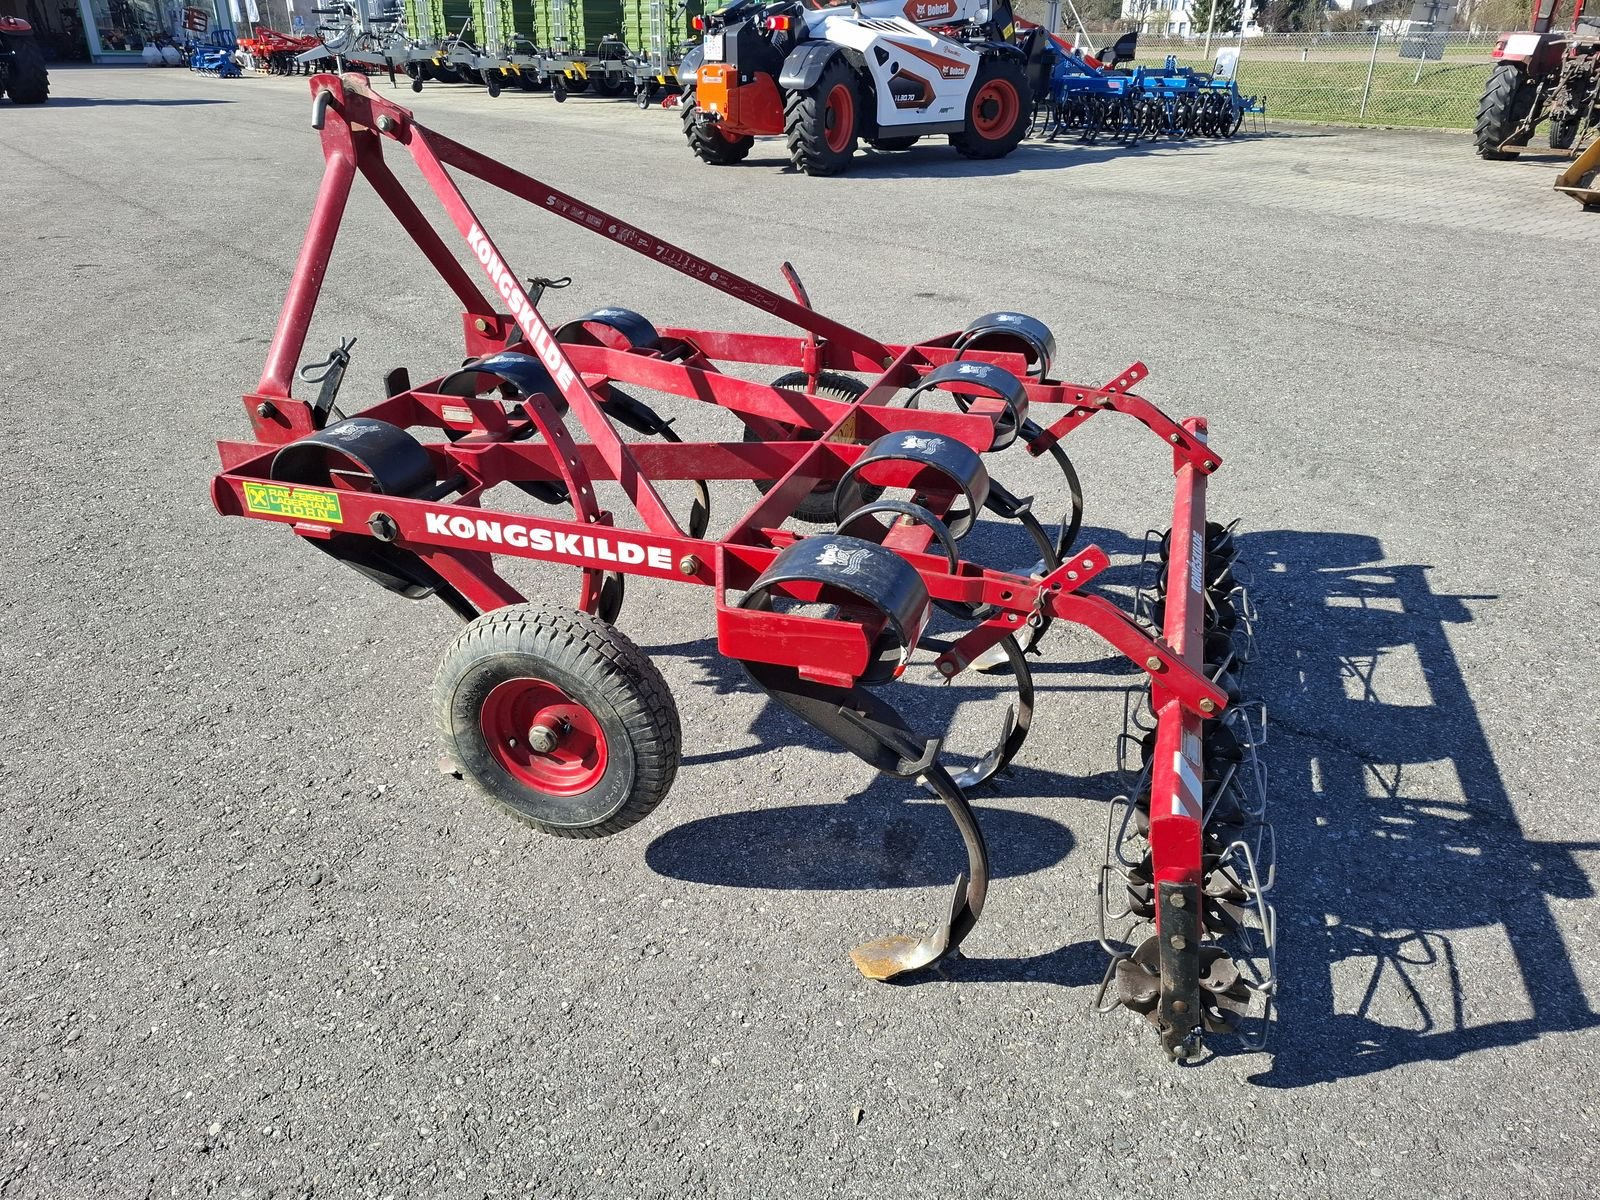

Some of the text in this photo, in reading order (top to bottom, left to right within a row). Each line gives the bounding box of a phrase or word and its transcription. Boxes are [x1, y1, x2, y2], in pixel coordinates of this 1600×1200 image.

[927, 3, 949, 16] Bobcat
[546, 195, 557, 206] 5
[608, 225, 617, 234] 6
[656, 245, 665, 255] 7
[709, 272, 719, 281] 8
[467, 224, 575, 392] KONGSKILDE
[270, 497, 336, 511] LAGERHAUS
[281, 505, 328, 518] HORN
[425, 512, 672, 570] KONGSKILDE
[1191, 530, 1202, 594] KONGSKILDE
